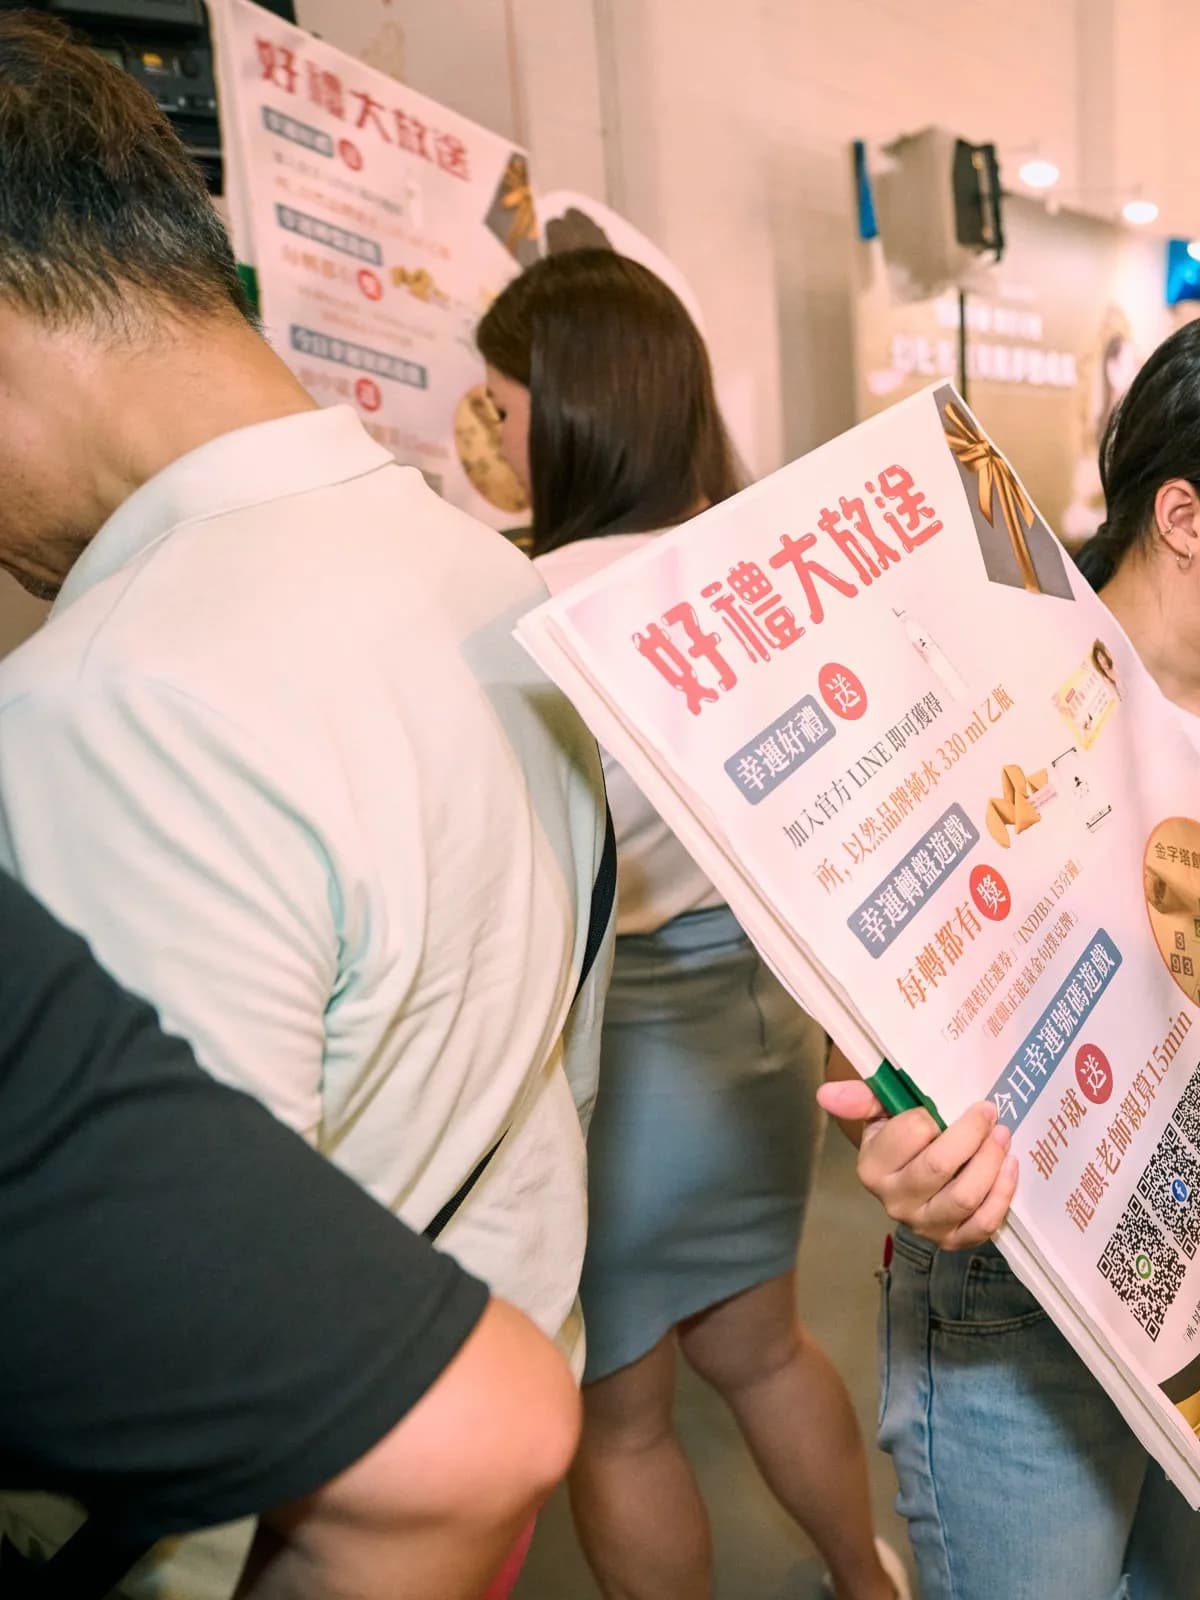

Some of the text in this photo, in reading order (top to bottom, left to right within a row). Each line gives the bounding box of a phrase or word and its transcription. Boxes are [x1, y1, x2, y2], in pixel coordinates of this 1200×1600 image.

[632, 464, 943, 715] 好禮大放送
[737, 673, 861, 792] 幸運好禮 送
[783, 692, 944, 848] 加入官方 LINE 即可獲得
[936, 733, 968, 772] 330
[965, 711, 988, 744] ml
[858, 814, 972, 943] 幸運轉盤遊戲
[896, 874, 1006, 1009] 每轉都有 獎
[993, 943, 1115, 1120] 今日幸運號碼遊戲
[1029, 1054, 1107, 1180] 抽中就 送
